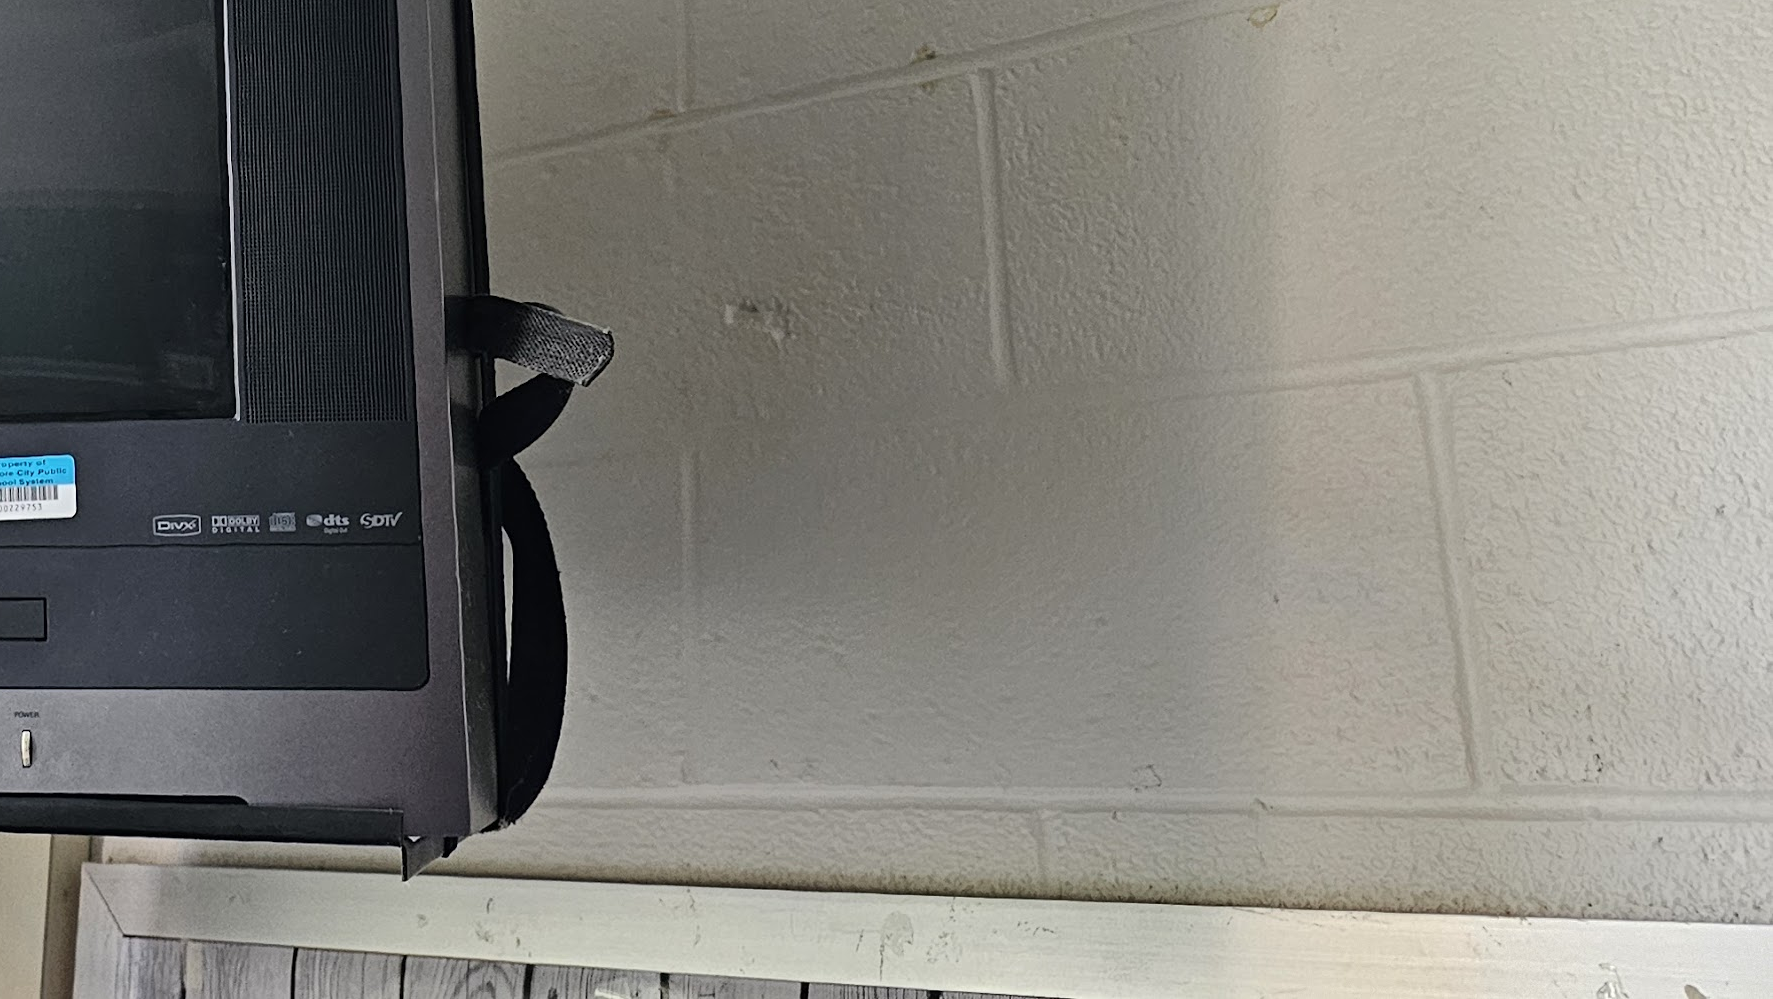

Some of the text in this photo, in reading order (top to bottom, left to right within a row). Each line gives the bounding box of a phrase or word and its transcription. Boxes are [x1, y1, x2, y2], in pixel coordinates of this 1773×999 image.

[17, 469, 35, 477] City
[38, 467, 67, 475] Public
[19, 478, 54, 486] System
[228, 515, 260, 527] DOLBY
[323, 513, 350, 526] dts
[212, 526, 260, 534] DIGITAL
